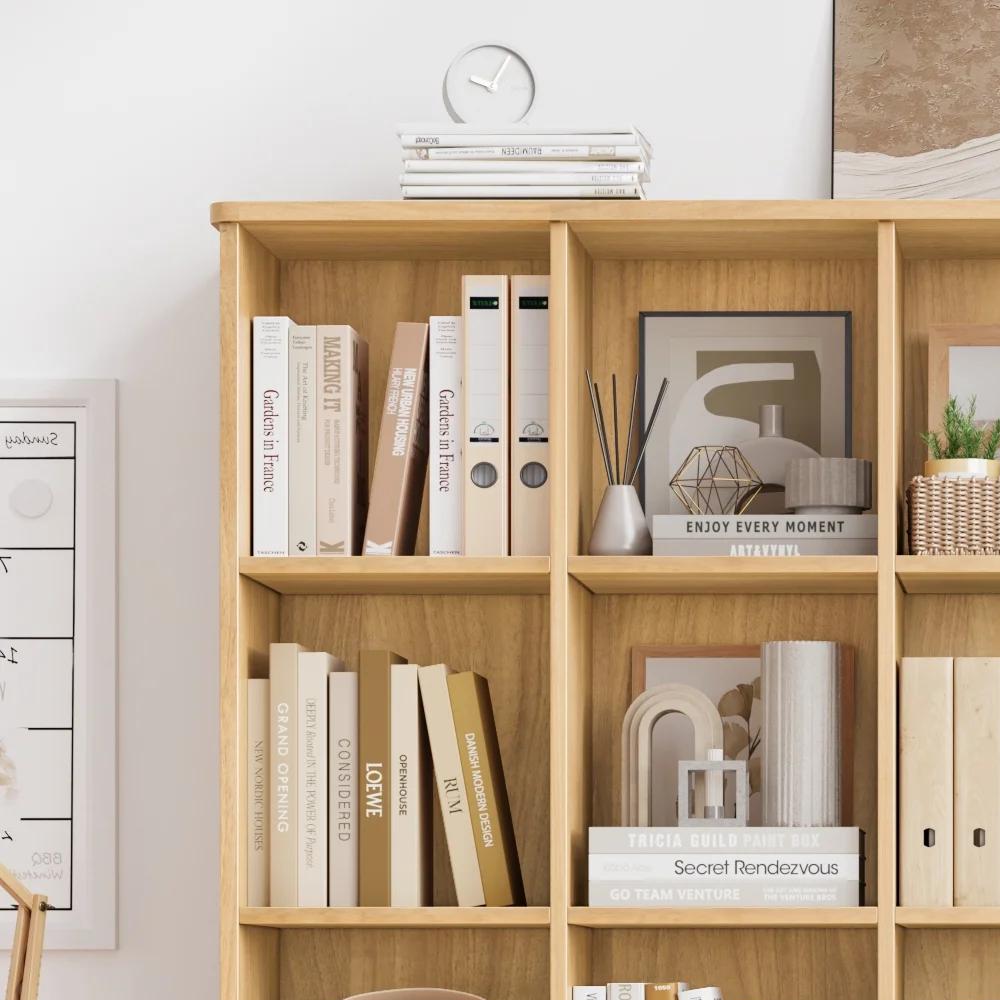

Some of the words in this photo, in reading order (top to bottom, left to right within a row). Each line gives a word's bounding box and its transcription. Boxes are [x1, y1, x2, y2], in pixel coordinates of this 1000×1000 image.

[323, 336, 341, 394] MAKING
[402, 367, 417, 387] NEW
[263, 389, 280, 437] Gardens
[323, 398, 341, 412] IT
[398, 388, 415, 418] URBAN
[439, 389, 455, 437] Gardens
[263, 440, 279, 451] in
[392, 417, 410, 457] HOUSING
[439, 440, 455, 450] in
[263, 454, 279, 493] France
[439, 454, 455, 492] France
[686, 520, 730, 533] ENJOY
[736, 520, 780, 533] EVERY
[785, 520, 845, 533] MOMENT
[277, 702, 289, 756] GRAND
[305, 698, 317, 729] DEEPLY
[254, 740, 264, 764] NEW
[306, 759, 316, 769] IN
[464, 732, 480, 769] DANISH
[254, 767, 264, 809] NORDIC
[306, 770, 316, 788] THE
[337, 738, 351, 842] CONSIDERED
[366, 762, 383, 818] LOEWE
[399, 754, 407, 816] OPENHOUSE
[443, 778, 463, 814] RUM
[472, 769, 488, 812] MODERN
[277, 762, 289, 833] OPENING
[306, 790, 316, 822] POWER
[254, 811, 264, 852] HOUSES
[306, 823, 316, 836] OF
[479, 812, 494, 849] DESIGN
[627, 833, 682, 848] TRICIA
[690, 833, 738, 848] GUILD
[742, 833, 785, 848] PAINT
[791, 833, 820, 848] BOX
[674, 859, 730, 875] Secret
[734, 859, 839, 875] Rendezvous
[609, 888, 631, 900] GO
[633, 888, 673, 900] TEAM
[677, 888, 741, 900] VENTURE
